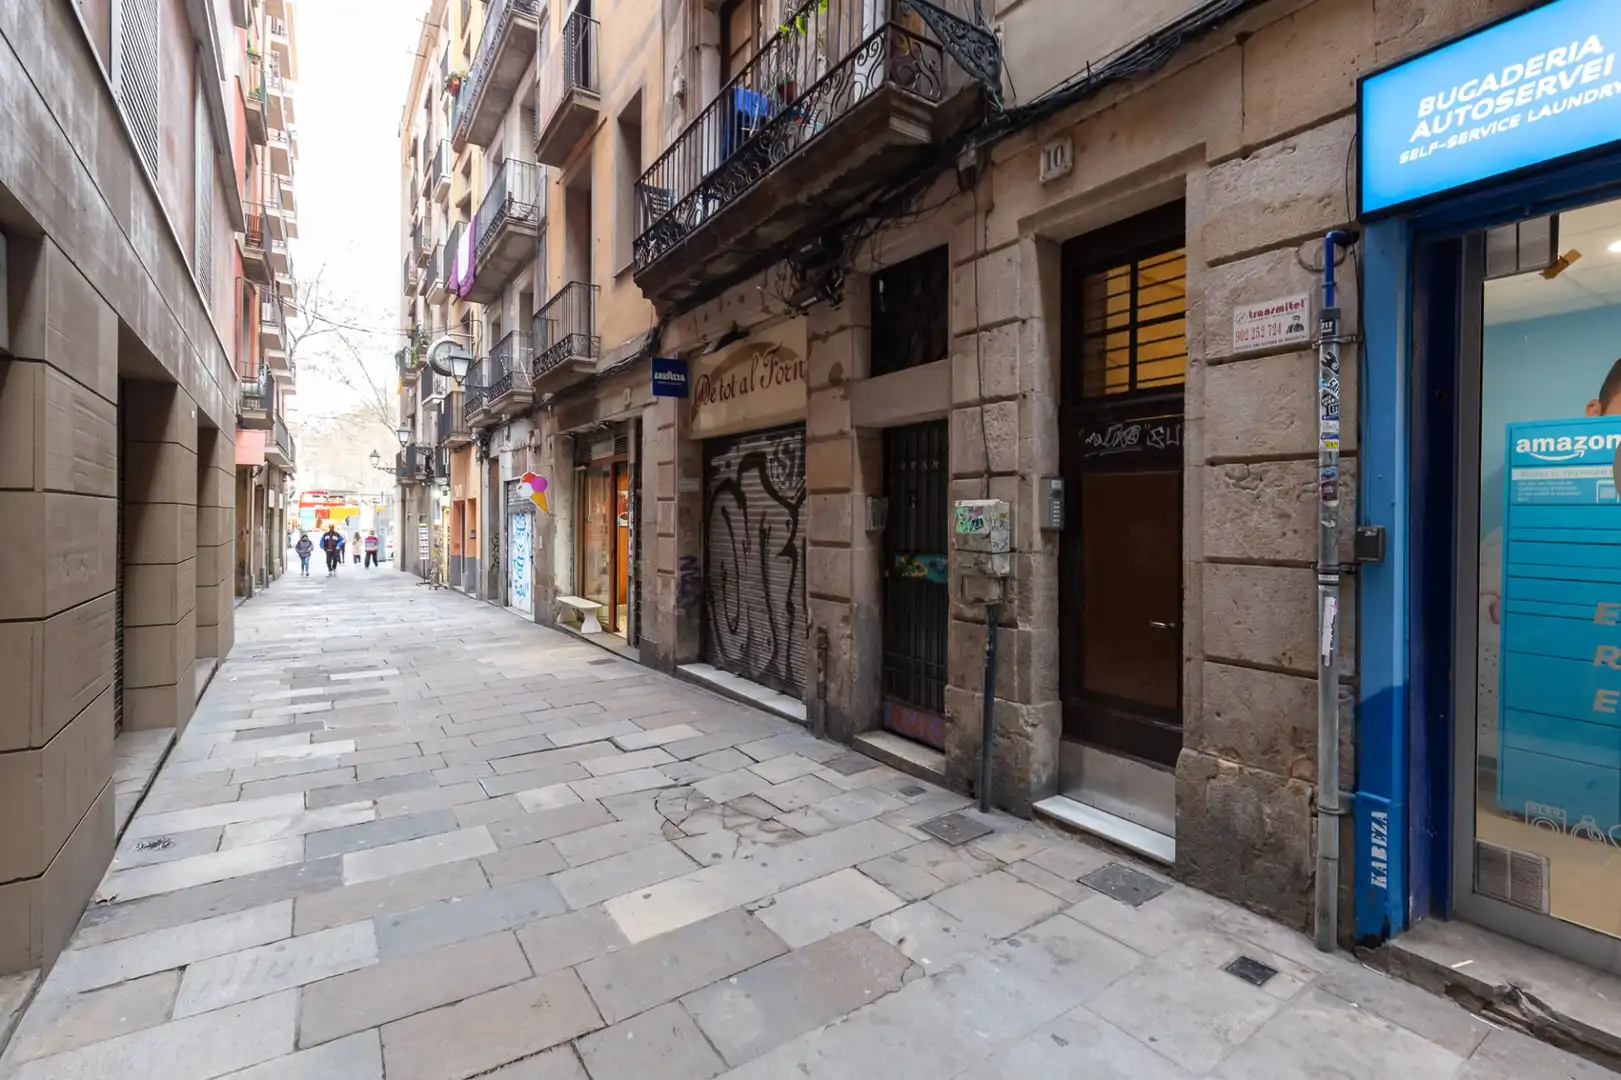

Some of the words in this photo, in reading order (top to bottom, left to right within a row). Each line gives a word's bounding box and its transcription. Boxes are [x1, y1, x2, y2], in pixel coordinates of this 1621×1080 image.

[1409, 53, 1615, 143] AUTOSERVEI
[1418, 34, 1604, 118] BUGADERIA
[1399, 114, 1521, 164] SELF-SERVICE
[1527, 81, 1621, 123] LAUNDRY
[1046, 144, 1064, 171] 10
[1248, 299, 1304, 318] transmitel
[1236, 329, 1249, 343] 902
[719, 377, 735, 402] tot
[738, 351, 759, 395] al
[1516, 433, 1621, 454] amazon
[1370, 811, 1388, 890] KABEZA
